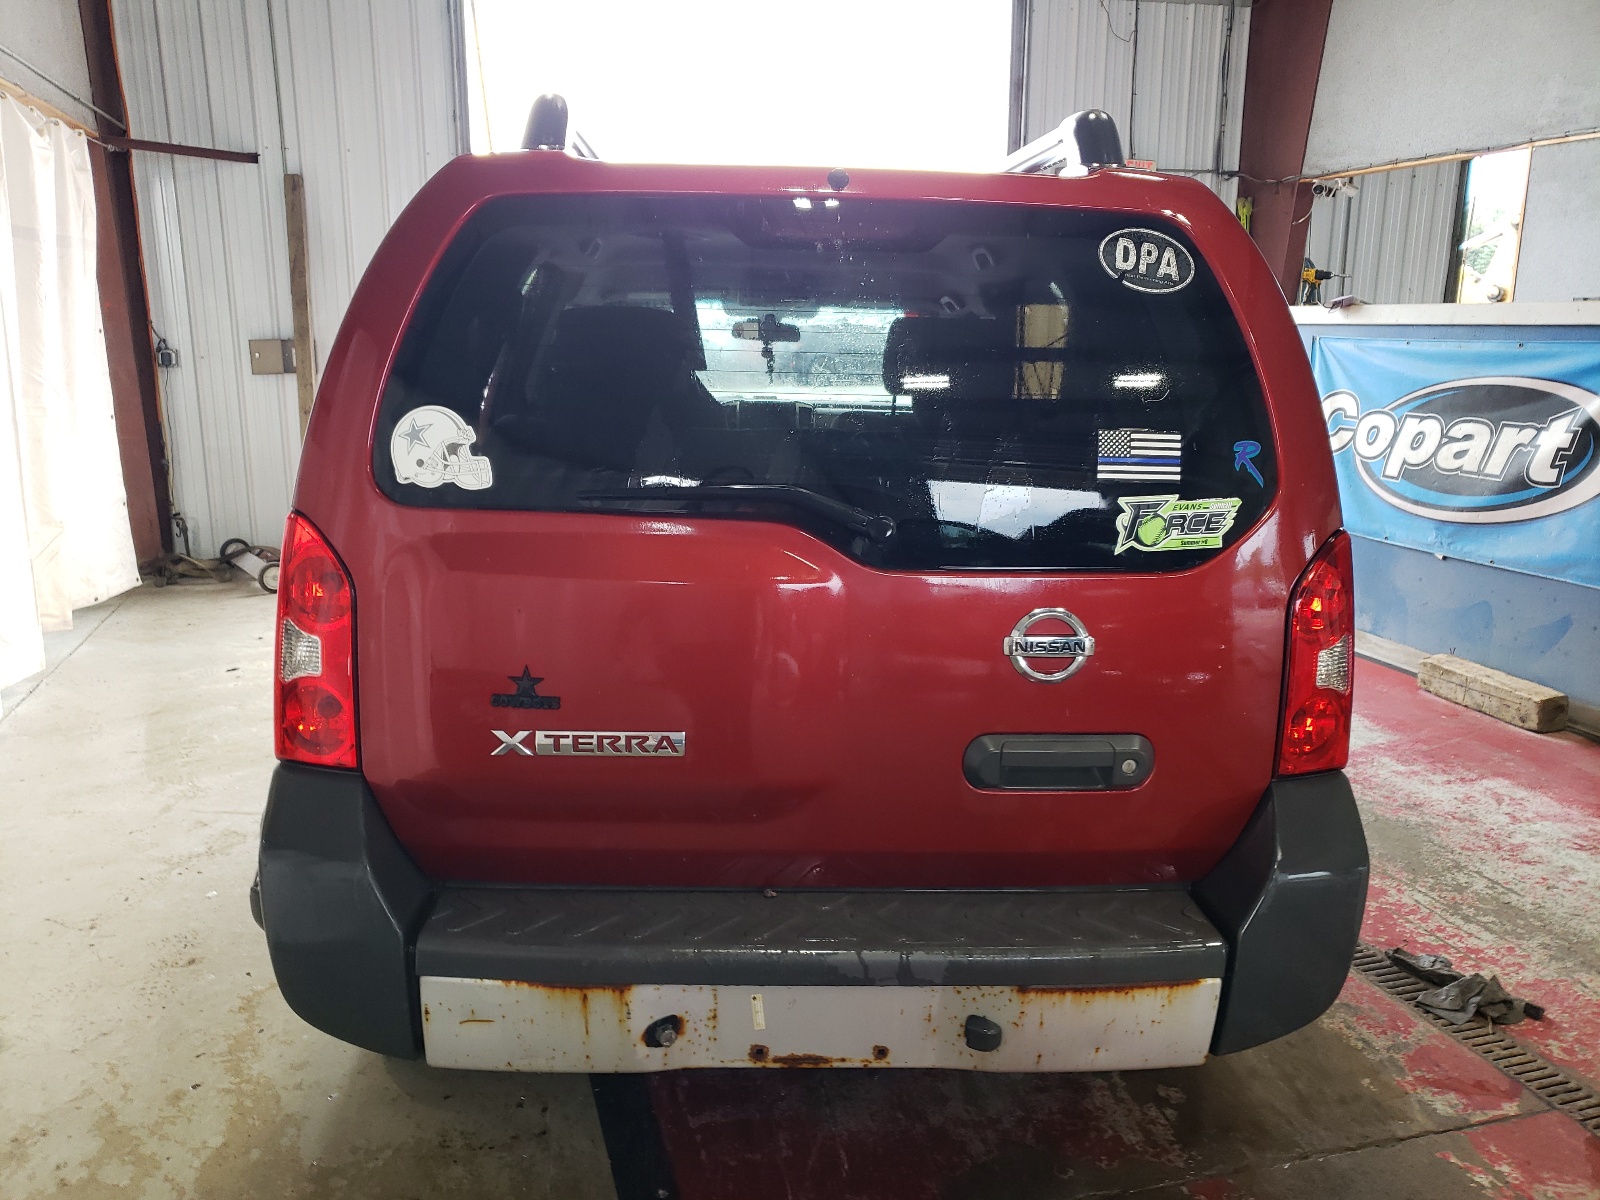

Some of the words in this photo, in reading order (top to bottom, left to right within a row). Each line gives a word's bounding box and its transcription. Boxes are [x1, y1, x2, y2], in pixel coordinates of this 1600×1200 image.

[1115, 237, 1180, 281] DPA
[1321, 389, 1583, 488] Copart
[1233, 440, 1264, 489] R
[1121, 500, 1232, 546] FORCE
[1172, 503, 1203, 511] EVANS
[1014, 641, 1086, 653] NISSAN
